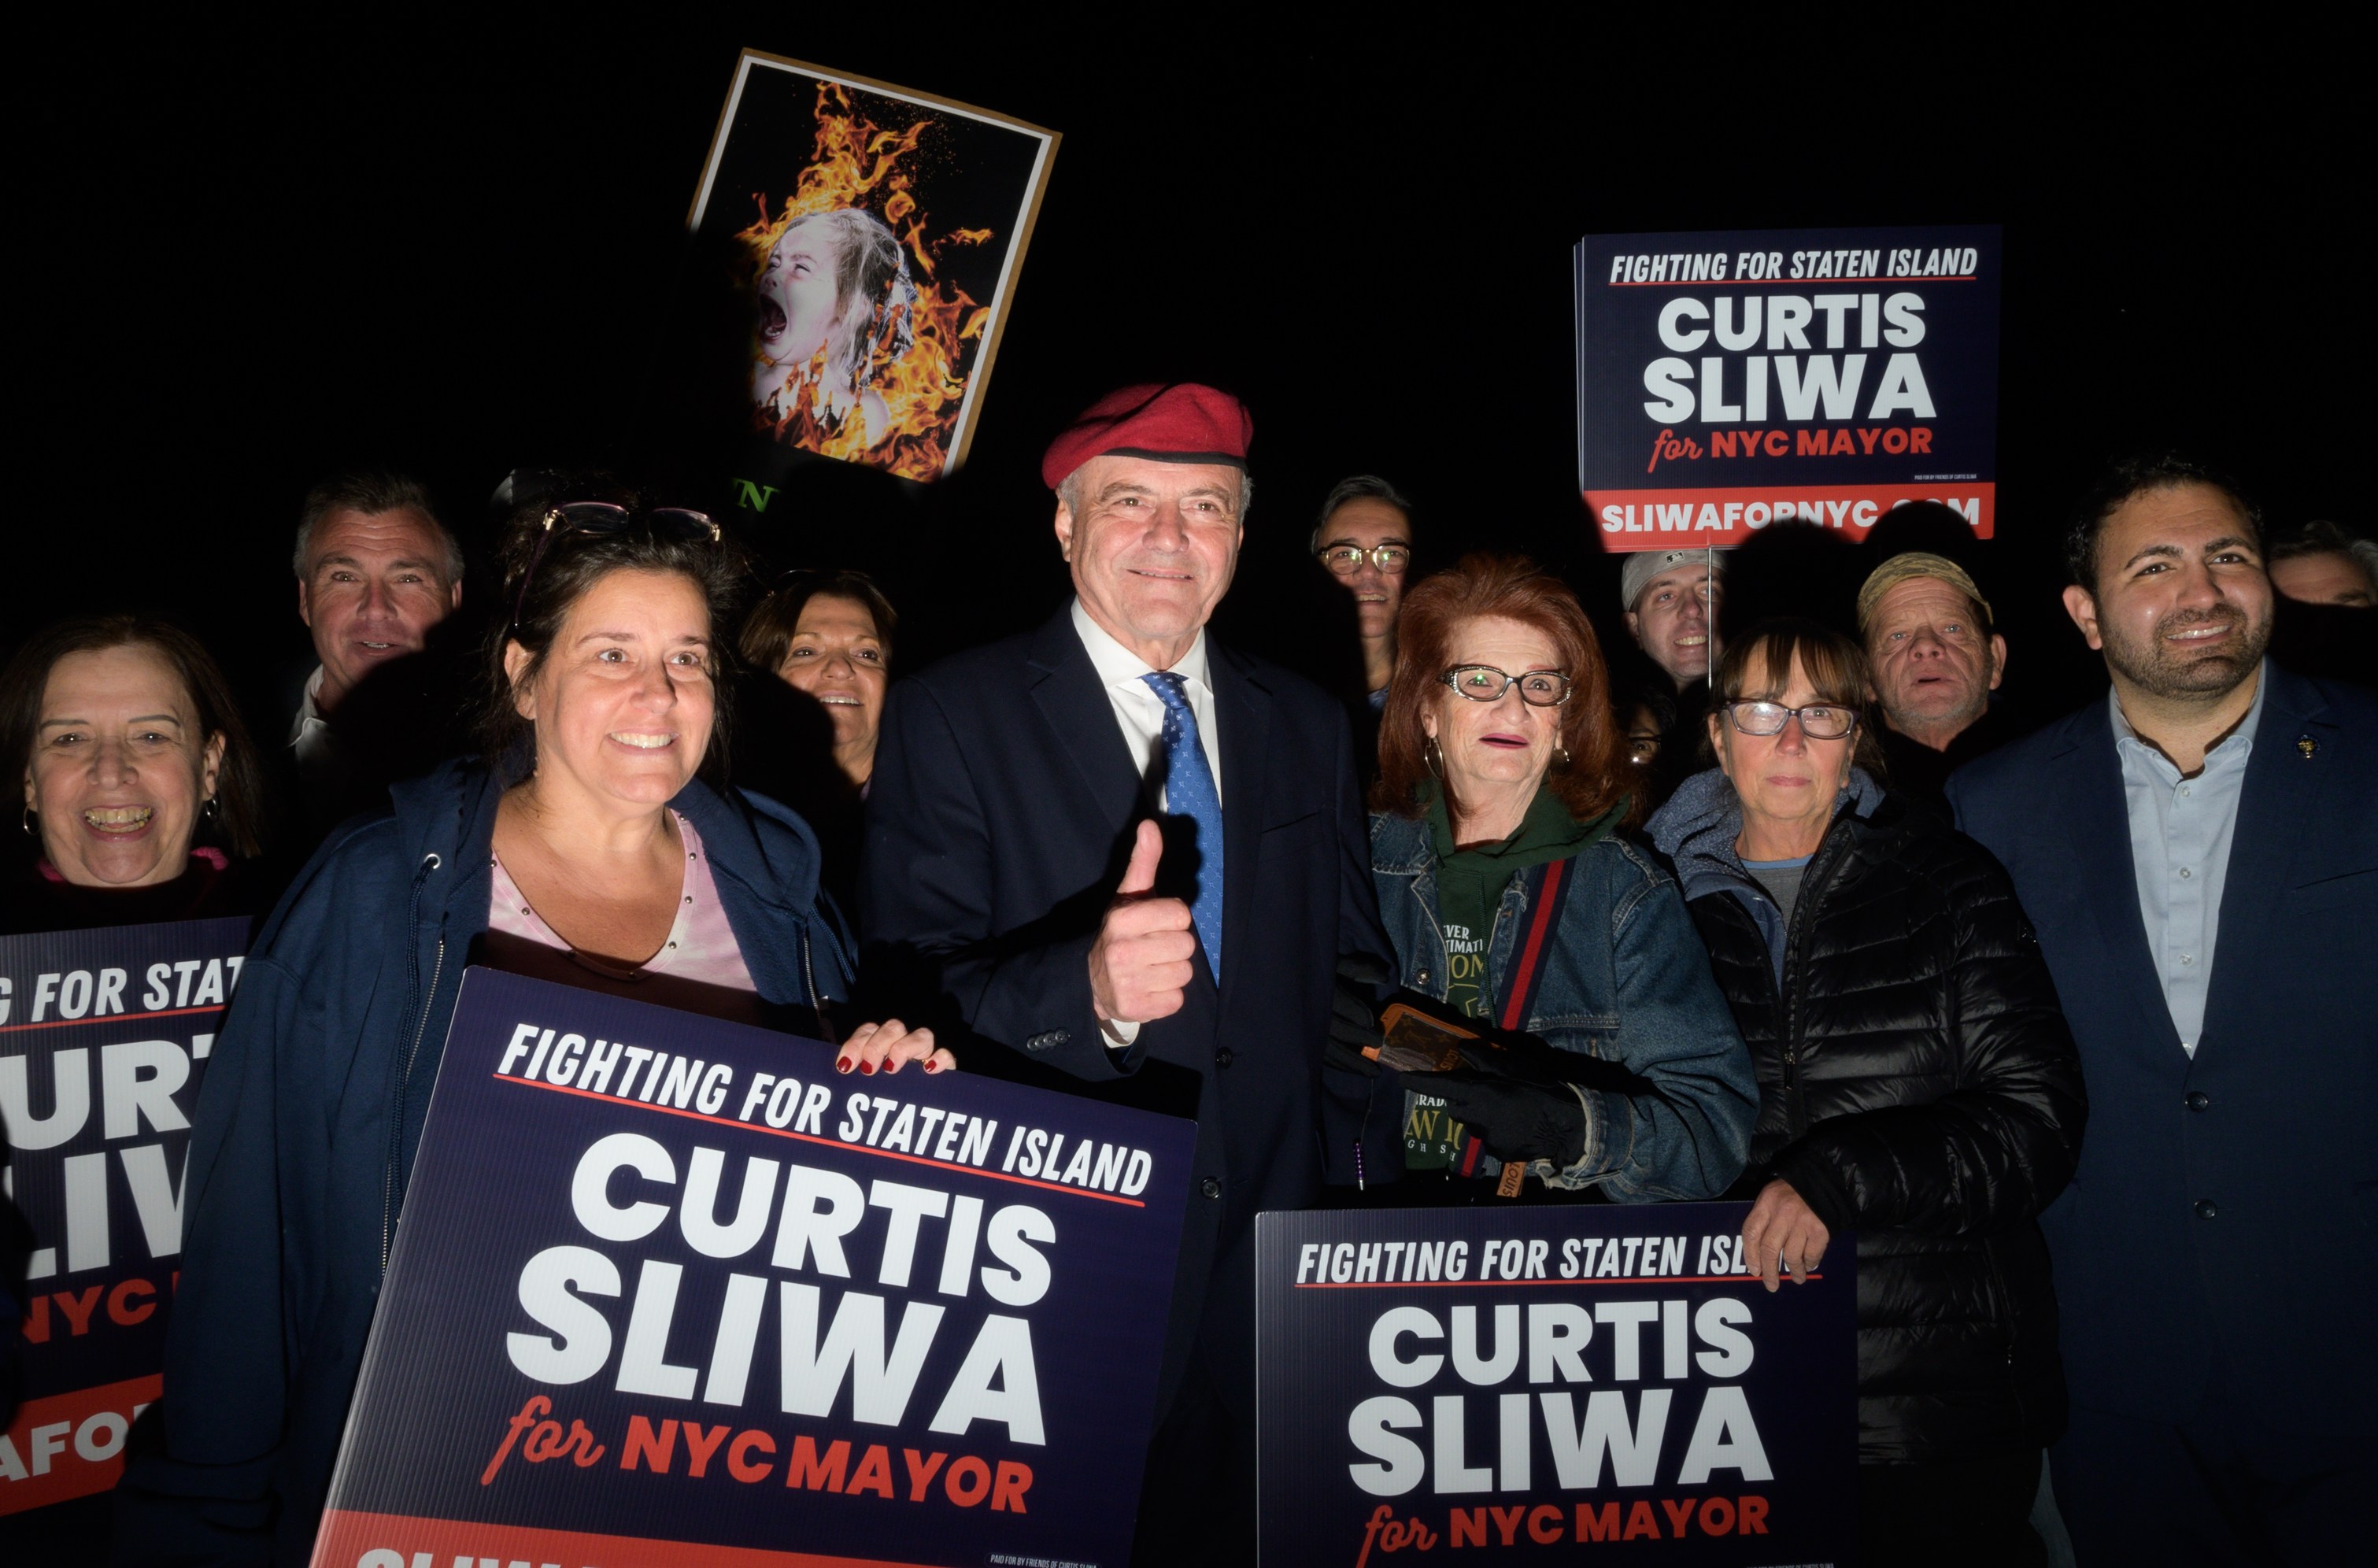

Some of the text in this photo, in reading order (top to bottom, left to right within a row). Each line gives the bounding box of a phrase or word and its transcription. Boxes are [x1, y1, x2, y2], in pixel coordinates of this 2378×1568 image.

[1610, 248, 1977, 285] FIGHTING FOR STATEN ISLAND
[1658, 292, 1925, 352] CURTIS
[1644, 353, 1936, 423] SLIWA
[1648, 427, 1932, 473] for NYC MAYOR
[1601, 497, 1980, 533] SLIWAFORNYCM
[31, 967, 128, 1023] FOR
[497, 1023, 1152, 1196] FIGHTING FOR STATEN ISLAND
[571, 1133, 1056, 1306] CURTIS
[1296, 1241, 1468, 1285] FIGHTING
[1480, 1240, 1548, 1281] FOR
[1559, 1237, 1687, 1278] STATEN
[506, 1245, 1045, 1446] SLIWA
[1369, 1298, 1754, 1388] CURTIS
[481, 1395, 1033, 1514] for NYC MAYOR
[1348, 1386, 1773, 1496] SLIWA
[1004, 1555, 1016, 1566] FOR
[1017, 1557, 1026, 1566] BY
[1357, 1496, 1769, 1568] for NYC MAYOR
